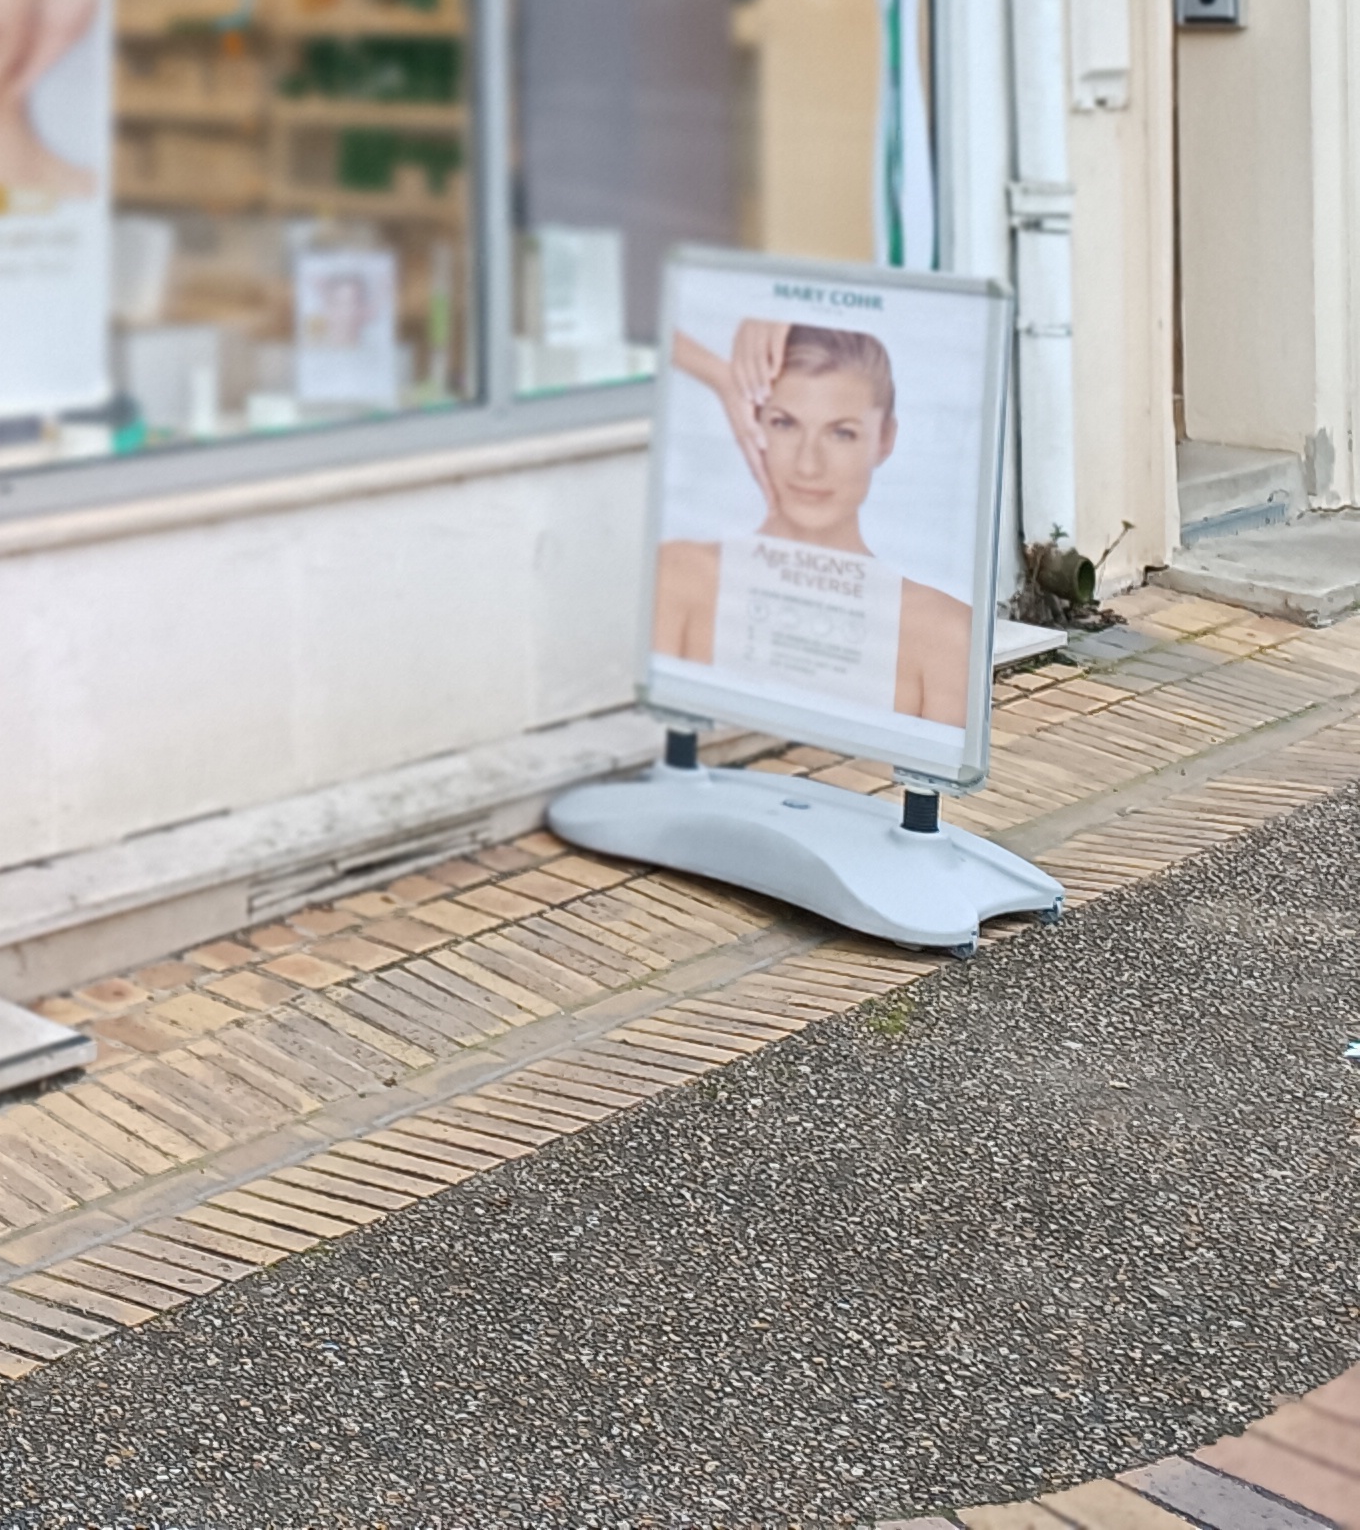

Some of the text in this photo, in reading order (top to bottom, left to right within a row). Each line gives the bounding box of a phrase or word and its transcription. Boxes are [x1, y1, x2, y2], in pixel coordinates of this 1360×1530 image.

[773, 281, 885, 312] MARY COHR
[781, 569, 865, 600] REVERSE
